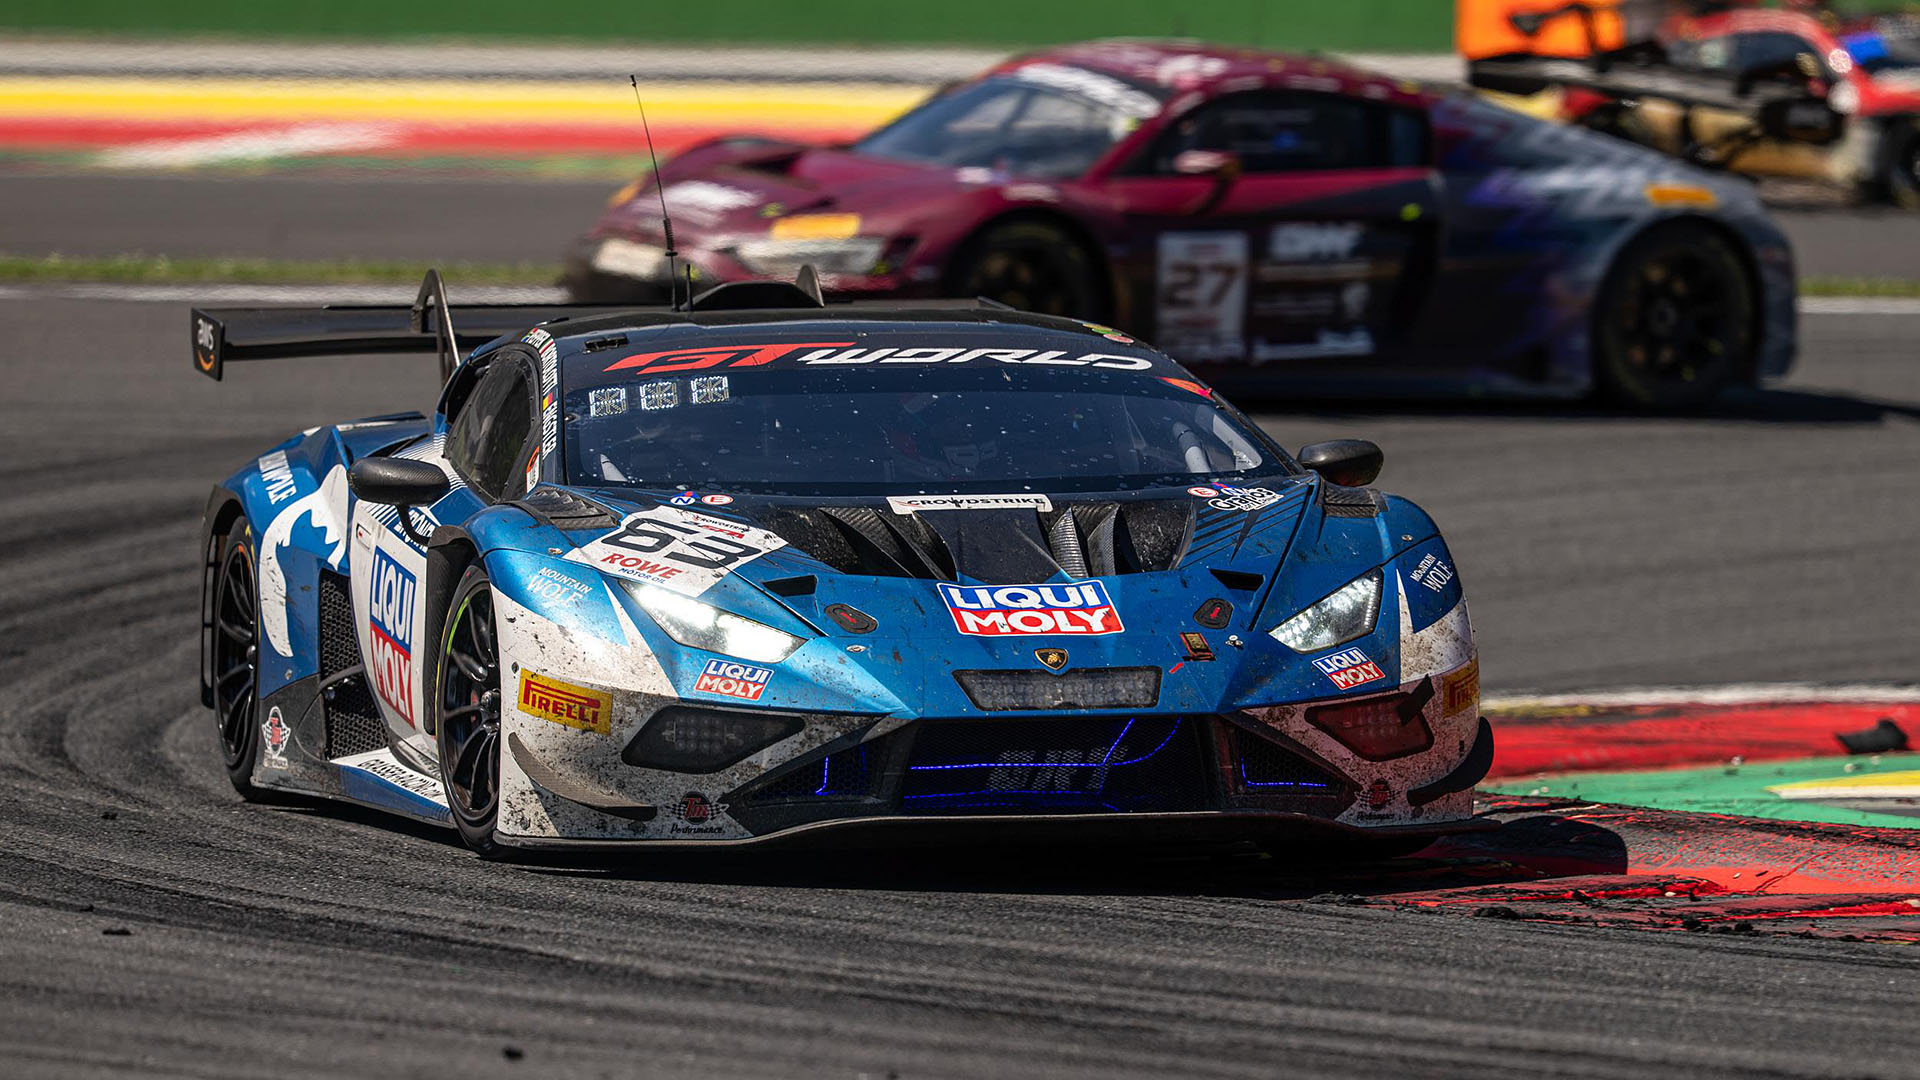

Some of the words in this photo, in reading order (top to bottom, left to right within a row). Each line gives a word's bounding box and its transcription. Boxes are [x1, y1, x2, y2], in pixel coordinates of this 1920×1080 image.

[1163, 263, 1238, 308] 27
[197, 318, 214, 350] aws
[602, 342, 856, 375] GT
[797, 348, 1152, 371] WORLD
[542, 400, 558, 460] ENGSTLER
[907, 498, 1045, 507] CROWDSTRIKE
[601, 517, 762, 569] 63
[601, 553, 684, 580] ROWE
[618, 567, 652, 581] MOTOR
[652, 576, 666, 585] OIL
[1410, 553, 1437, 582] MOUNTAIN
[1421, 561, 1453, 591] WOLF
[538, 567, 592, 594] MOUNTAIN
[371, 553, 414, 645] LIQUI
[947, 584, 1102, 609] LIQUI
[959, 607, 1111, 633] MOLY
[706, 661, 769, 684] LIQUI
[1316, 649, 1367, 673] LIQUI
[371, 630, 412, 720] MOLY
[699, 675, 763, 698] MOLY
[1332, 663, 1380, 687] MOLY
[523, 679, 601, 724] PIRELLI
[670, 823, 725, 835] Performance
